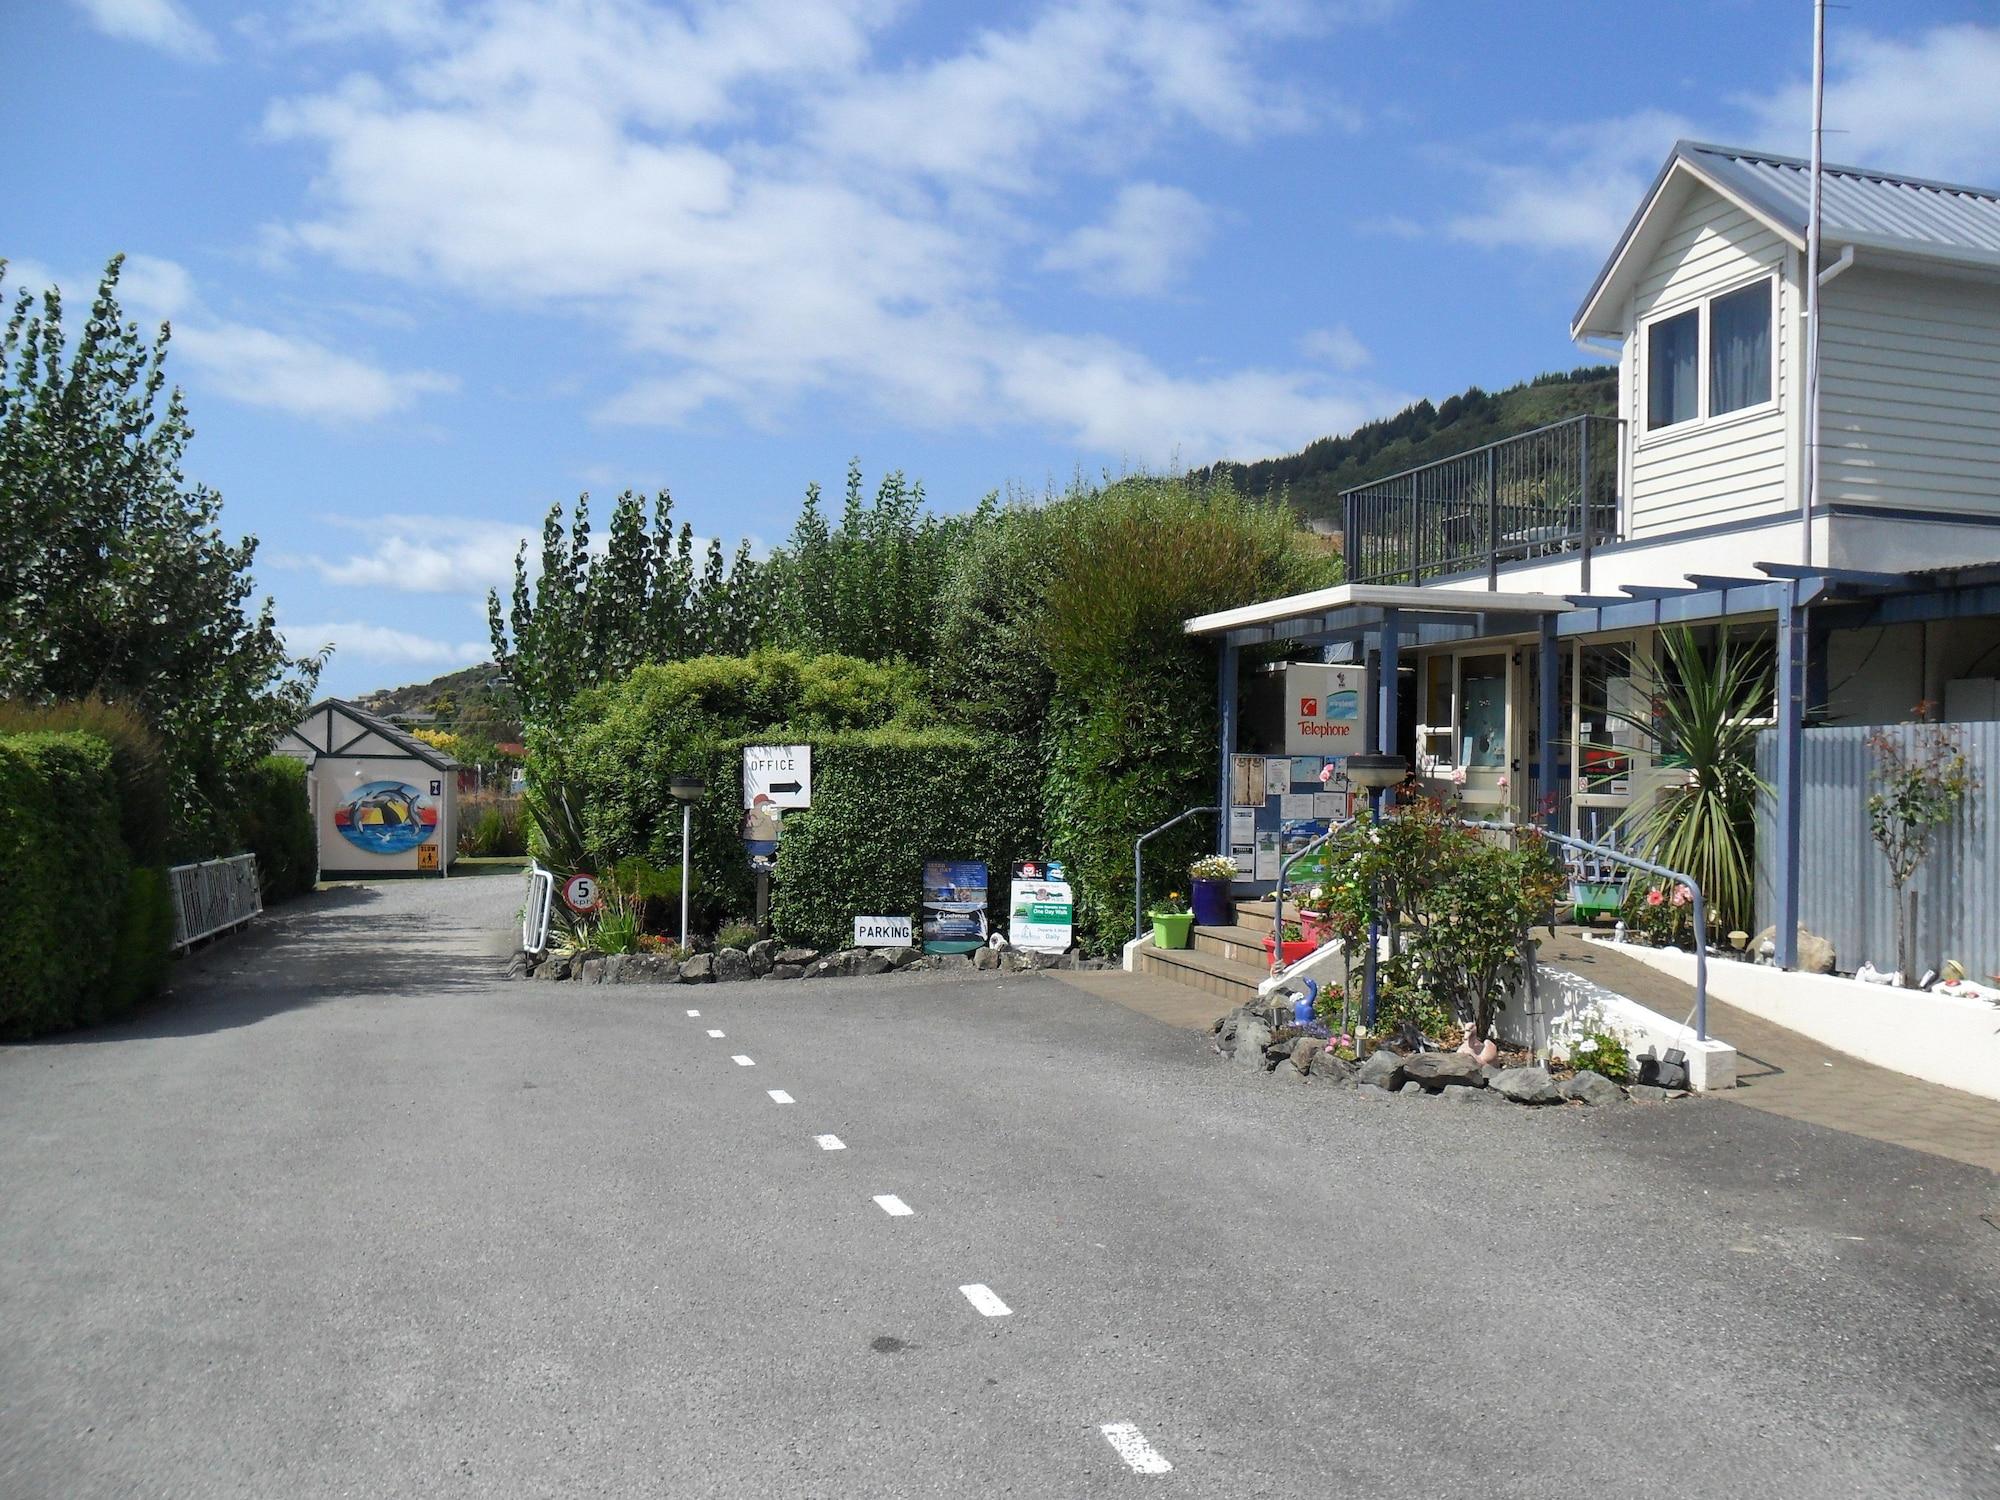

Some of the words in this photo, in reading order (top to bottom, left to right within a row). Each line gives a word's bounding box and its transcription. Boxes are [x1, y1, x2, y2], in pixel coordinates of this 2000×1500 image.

[1298, 721, 1350, 738] Telephone
[751, 759, 795, 771] OFFICE
[578, 881, 590, 898] 5
[859, 926, 910, 938] PARKING
